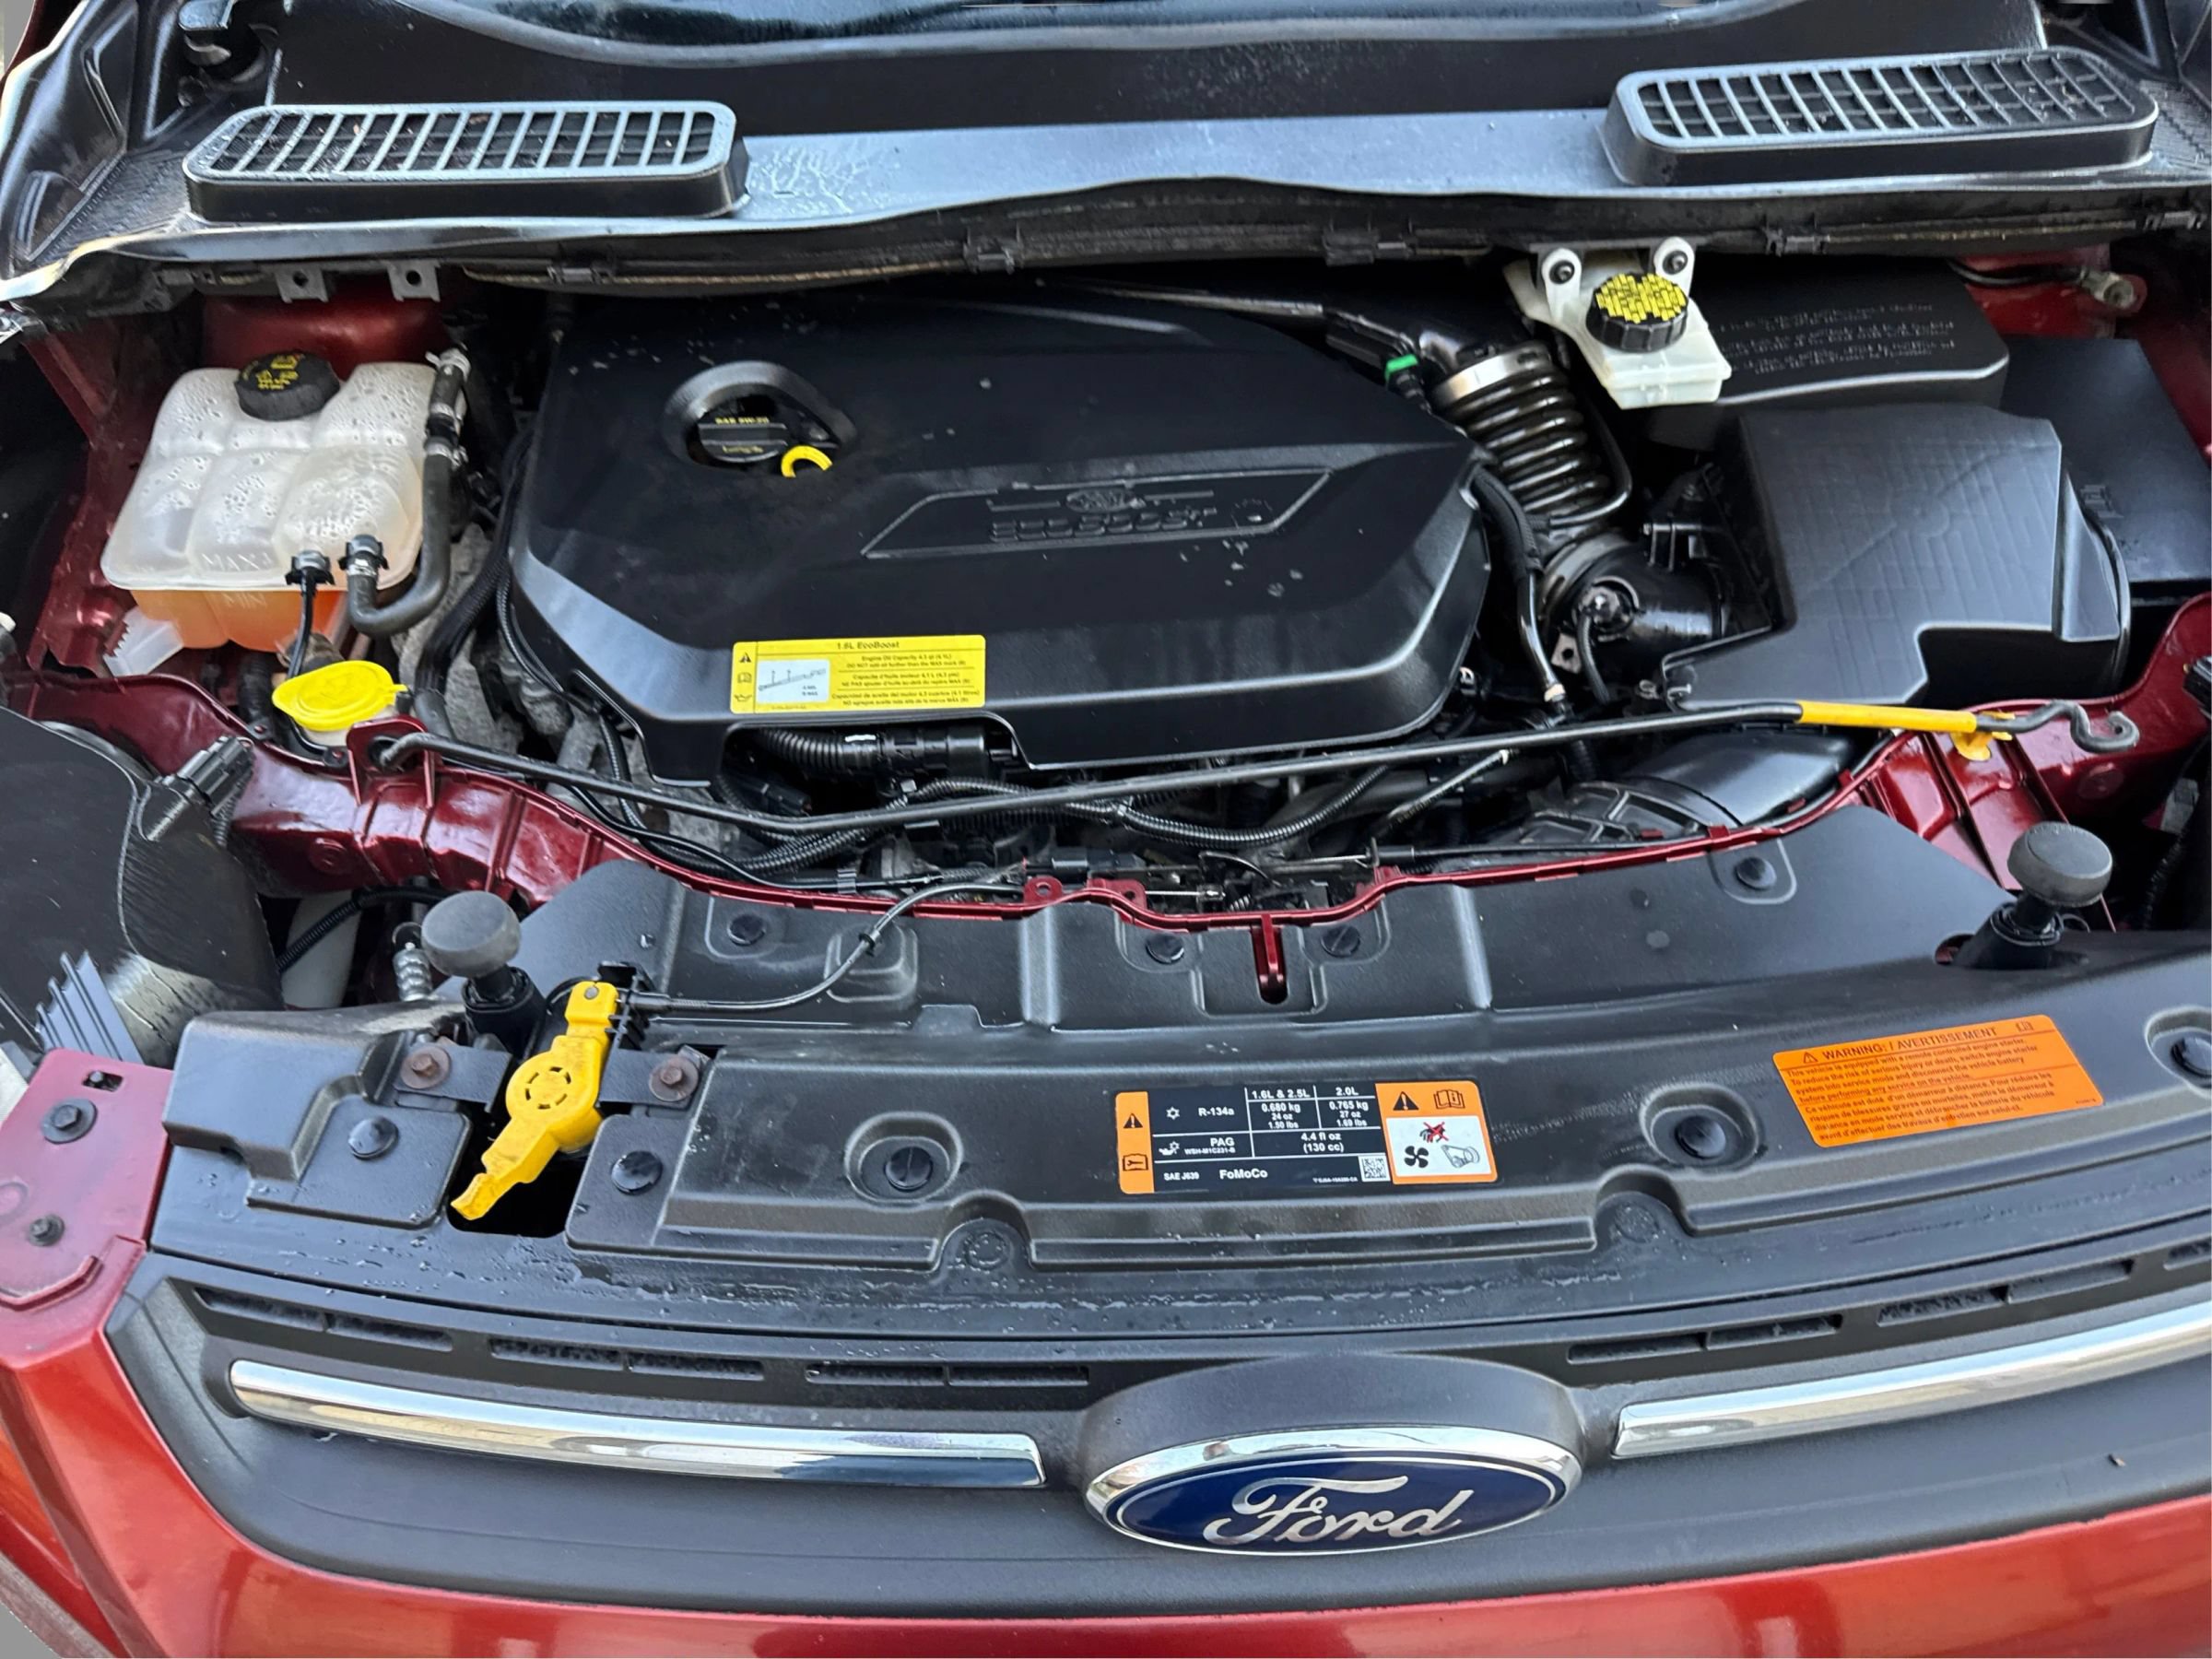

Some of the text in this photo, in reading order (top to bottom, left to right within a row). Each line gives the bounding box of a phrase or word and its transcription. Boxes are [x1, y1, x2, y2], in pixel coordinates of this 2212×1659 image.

[1823, 1043, 1887, 1059] WARNING:
[1897, 1028, 1998, 1049] AVERTISSEMENT
[1252, 1088, 1310, 1100] 1.6L & 2.5L
[1335, 1087, 1359, 1096] 2.0L
[1198, 1106, 1235, 1117] R-134a
[1262, 1101, 1300, 1113] 0.680 kg
[1329, 1100, 1369, 1112] 0.765 kg
[1268, 1121, 1285, 1129] 1.50
[1336, 1119, 1353, 1127] 1.69
[1210, 1137, 1235, 1147] PAG
[1301, 1132, 1342, 1142] 4.4 fl oz
[1303, 1141, 1344, 1154] (130 cc)
[1164, 1172, 1181, 1182] SAE
[1219, 1168, 1268, 1180] FoMoCo
[1203, 1476, 1475, 1546] Ford
